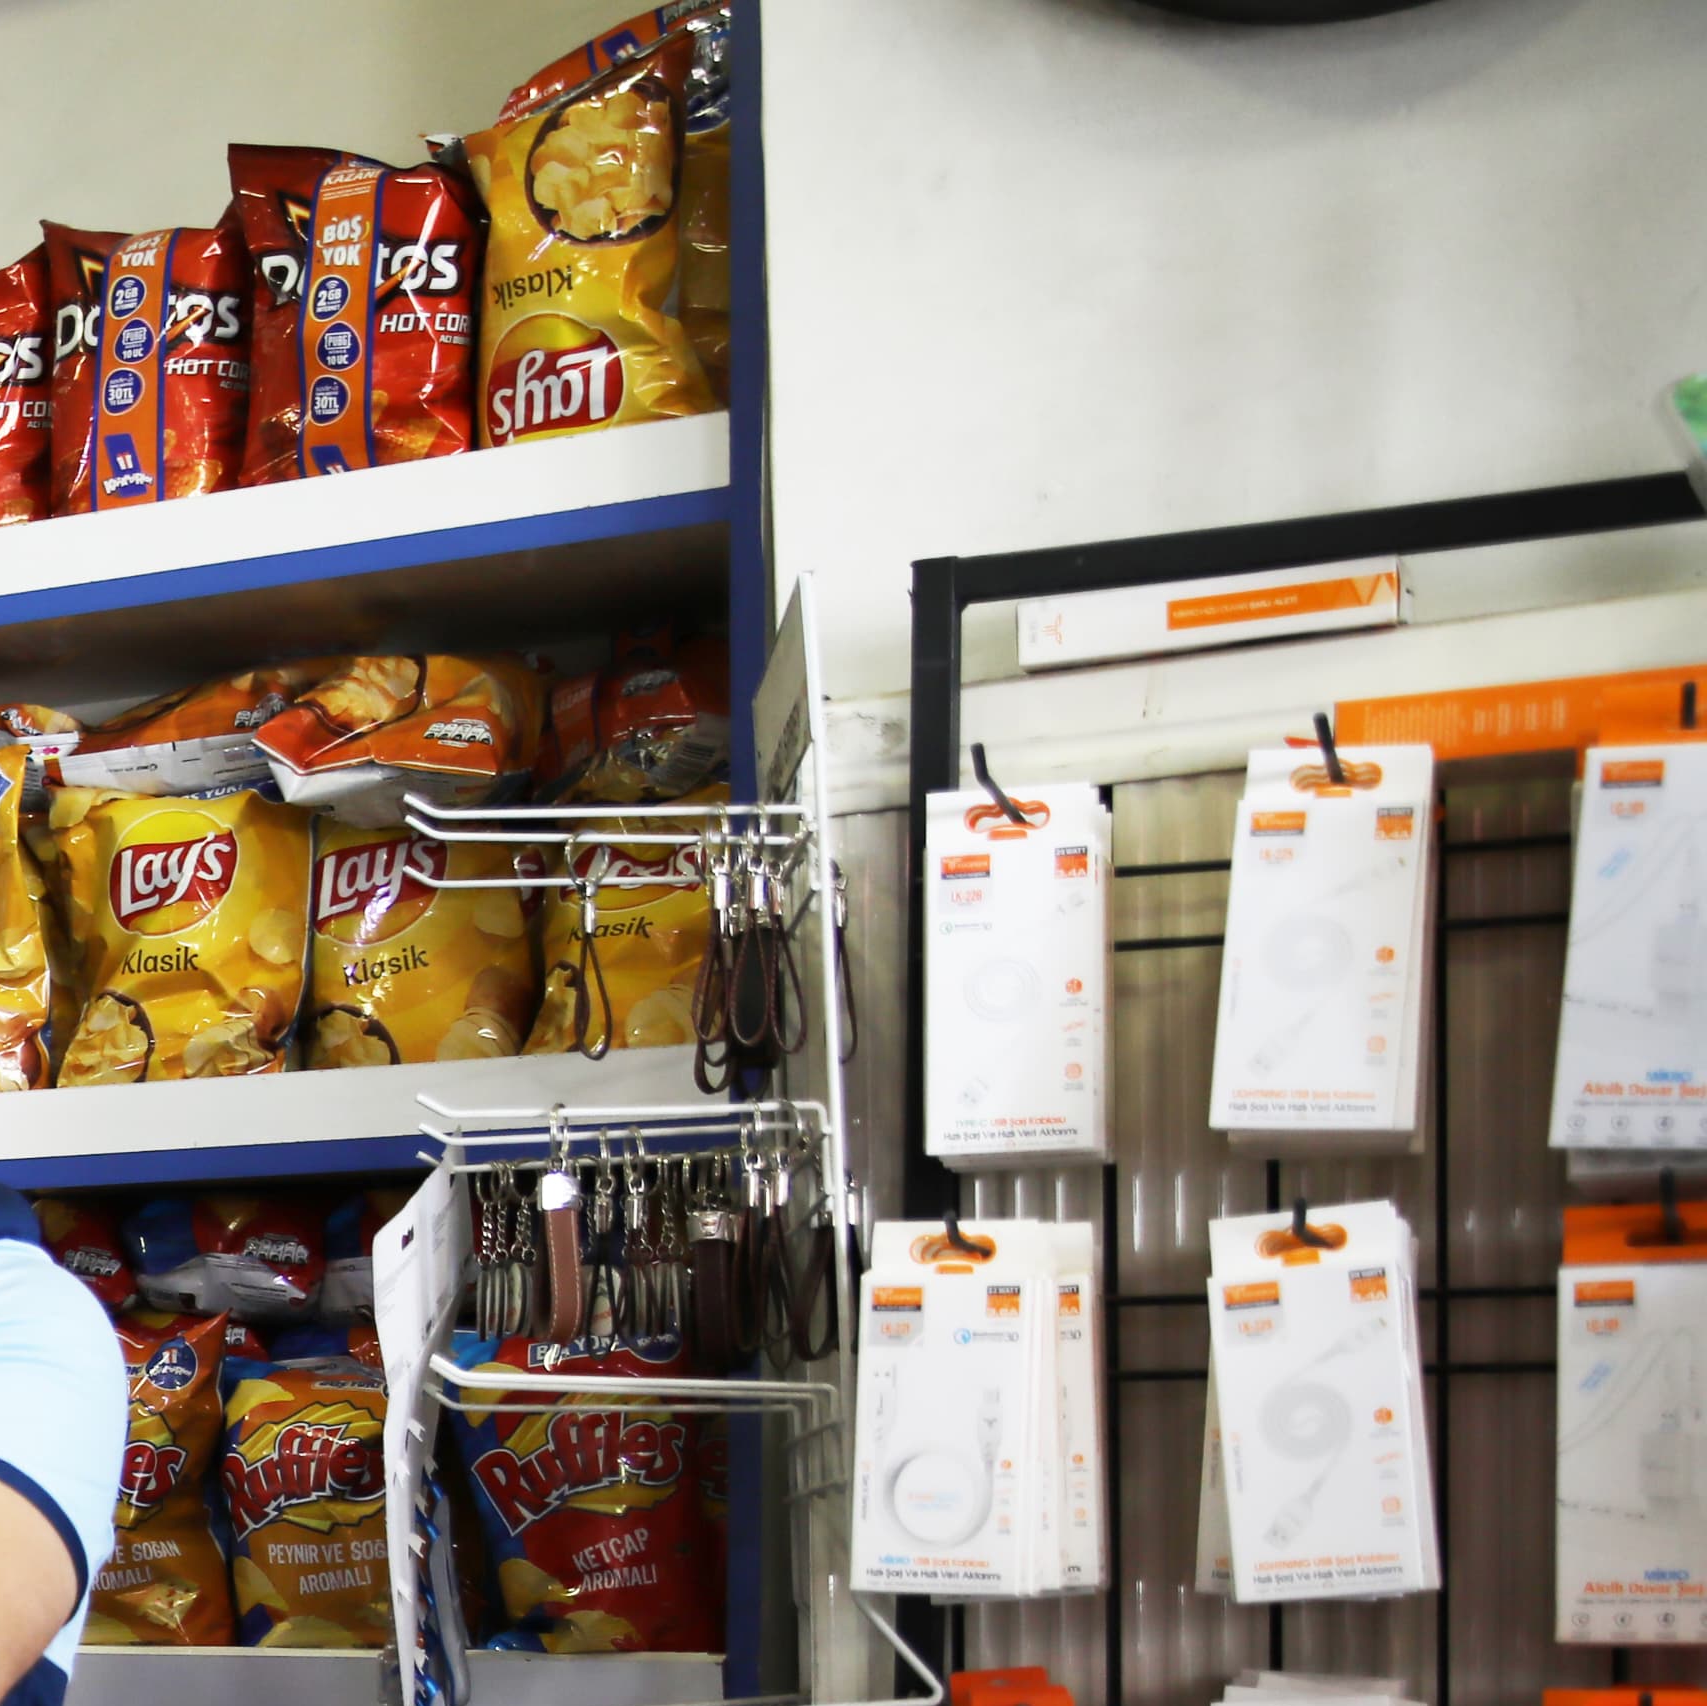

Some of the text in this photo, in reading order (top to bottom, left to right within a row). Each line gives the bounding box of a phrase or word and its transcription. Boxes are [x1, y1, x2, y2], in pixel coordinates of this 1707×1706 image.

[323, 217, 361, 243] BOŞ
[121, 248, 156, 267] YOK
[322, 249, 361, 267] YOK
[492, 266, 572, 311] Klasik
[380, 313, 429, 333] HOT
[166, 360, 212, 375] HOT
[117, 830, 230, 913] Lay's
[120, 945, 200, 974] Klasik
[343, 944, 430, 988] Klasik
[471, 1406, 686, 1537] Ruffles
[132, 1539, 181, 1560] SOĞAN
[322, 1541, 344, 1563] VE
[573, 1528, 650, 1572] KETÇAP
[299, 1569, 372, 1596] AROMALI
[580, 1563, 658, 1593] AROMALI
